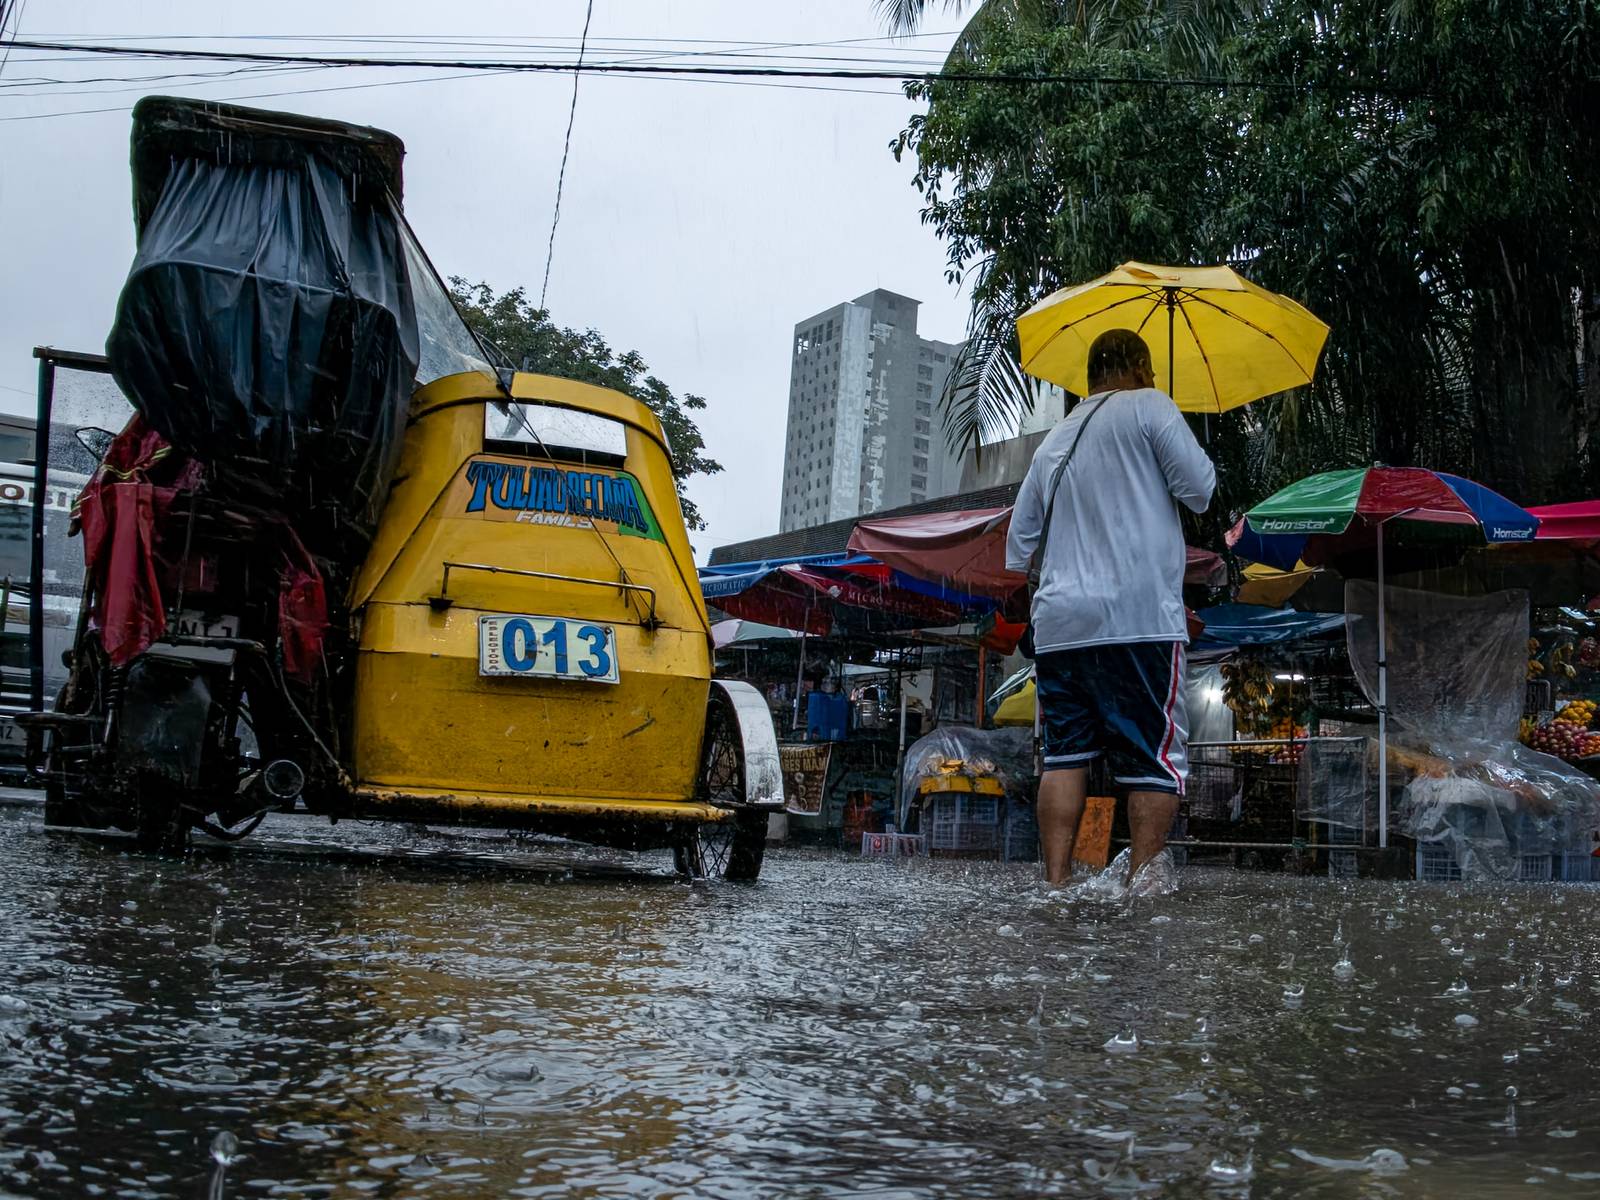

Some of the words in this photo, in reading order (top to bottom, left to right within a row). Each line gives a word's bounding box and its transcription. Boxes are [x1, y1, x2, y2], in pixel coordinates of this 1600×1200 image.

[1261, 519, 1330, 530] Homstar
[1493, 528, 1531, 539] Homstar
[502, 618, 611, 678] 013
